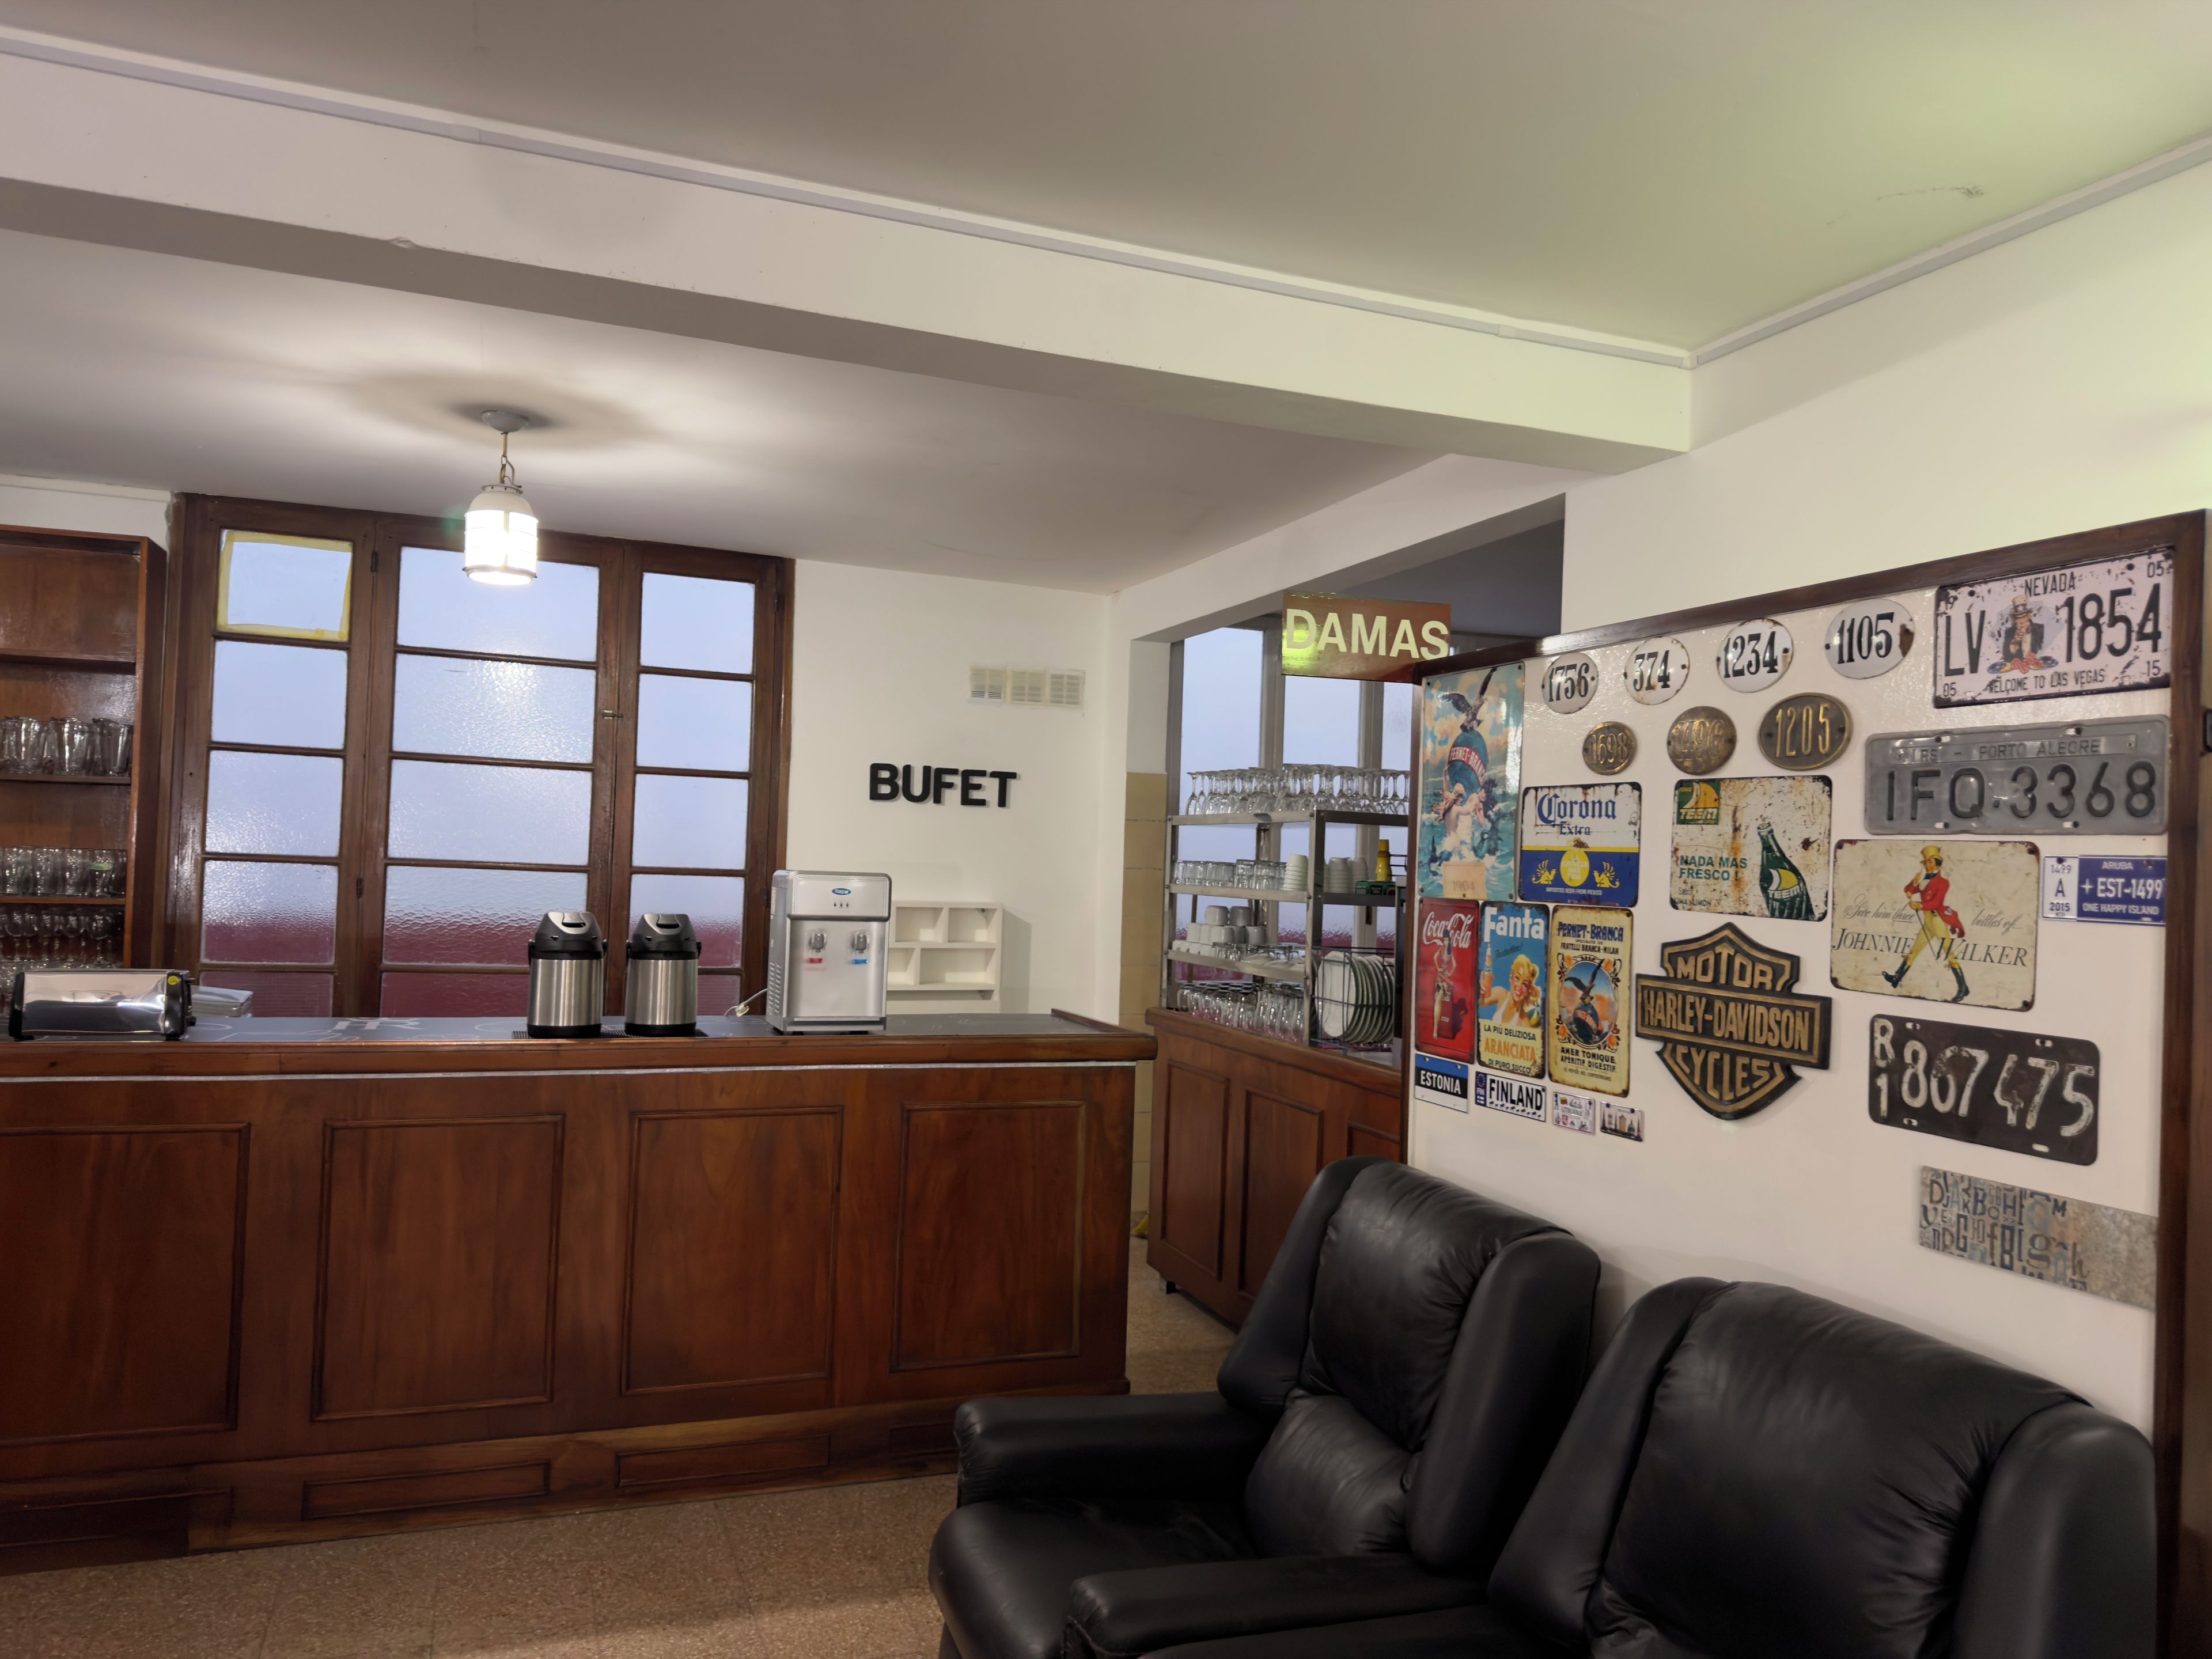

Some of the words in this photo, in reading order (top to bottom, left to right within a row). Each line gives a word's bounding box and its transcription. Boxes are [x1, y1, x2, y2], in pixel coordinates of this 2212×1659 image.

[2147, 560, 2164, 578] 05
[2024, 571, 2075, 597] NEVADA
[1286, 608, 1449, 660] DAMAS
[1837, 612, 1895, 664] 1105
[1945, 610, 1985, 677] LV
[2063, 583, 2161, 664] 1854
[1724, 631, 1779, 679] 1234
[1634, 650, 1670, 691] 374
[2034, 675, 2045, 688] TO
[2051, 671, 2068, 687] LAS
[2074, 669, 2105, 685] VEGAS
[2146, 660, 2161, 677] 15
[1548, 662, 1590, 702] 1756
[1775, 703, 1831, 757] 1205
[1591, 732, 1628, 764] 1698
[1979, 743, 2027, 760] PORTO
[2037, 740, 2101, 756] ALEGRE
[869, 763, 1017, 807] BUFET
[1537, 793, 1617, 827] Corona
[1680, 808, 1718, 819] TEEM
[1559, 821, 1590, 835] Extra
[1679, 868, 1730, 881] FRESCO
[1680, 855, 1714, 867] NADA
[1719, 857, 1748, 869] MAS
[2051, 865, 2071, 873] 1499
[2101, 862, 2133, 870] ARUBA
[2055, 878, 2065, 897] A
[2097, 878, 2162, 899] EST-1499
[2050, 902, 2070, 911] 2015
[2082, 903, 2099, 912] ONE
[2100, 904, 2127, 913] HAPPY
[2128, 905, 2160, 915] ISLAND
[1422, 911, 1474, 949] Coca-Cola
[1484, 907, 1544, 942] Fanta
[1832, 929, 1914, 955] JOHNNIE
[1936, 937, 2028, 966] WALKER
[1677, 943, 1773, 990] MOTOR
[1643, 990, 1810, 1051] HARLEY-DAVIDSON
[1505, 1028, 1536, 1041] DELIZIOSA
[1873, 1018, 1895, 1067] R
[1484, 1037, 1536, 1062] ARANCIATA
[1560, 1047, 1580, 1056] AMER
[1495, 1060, 1510, 1069] PURO
[1512, 1064, 1531, 1074] SUCCO
[1676, 1045, 1771, 1101] CYCLES
[1420, 1070, 1461, 1094] ESTONIA
[1476, 1088, 1484, 1096] FIN
[1489, 1078, 1543, 1111] FINLAND
[1876, 1073, 1888, 1118] 1
